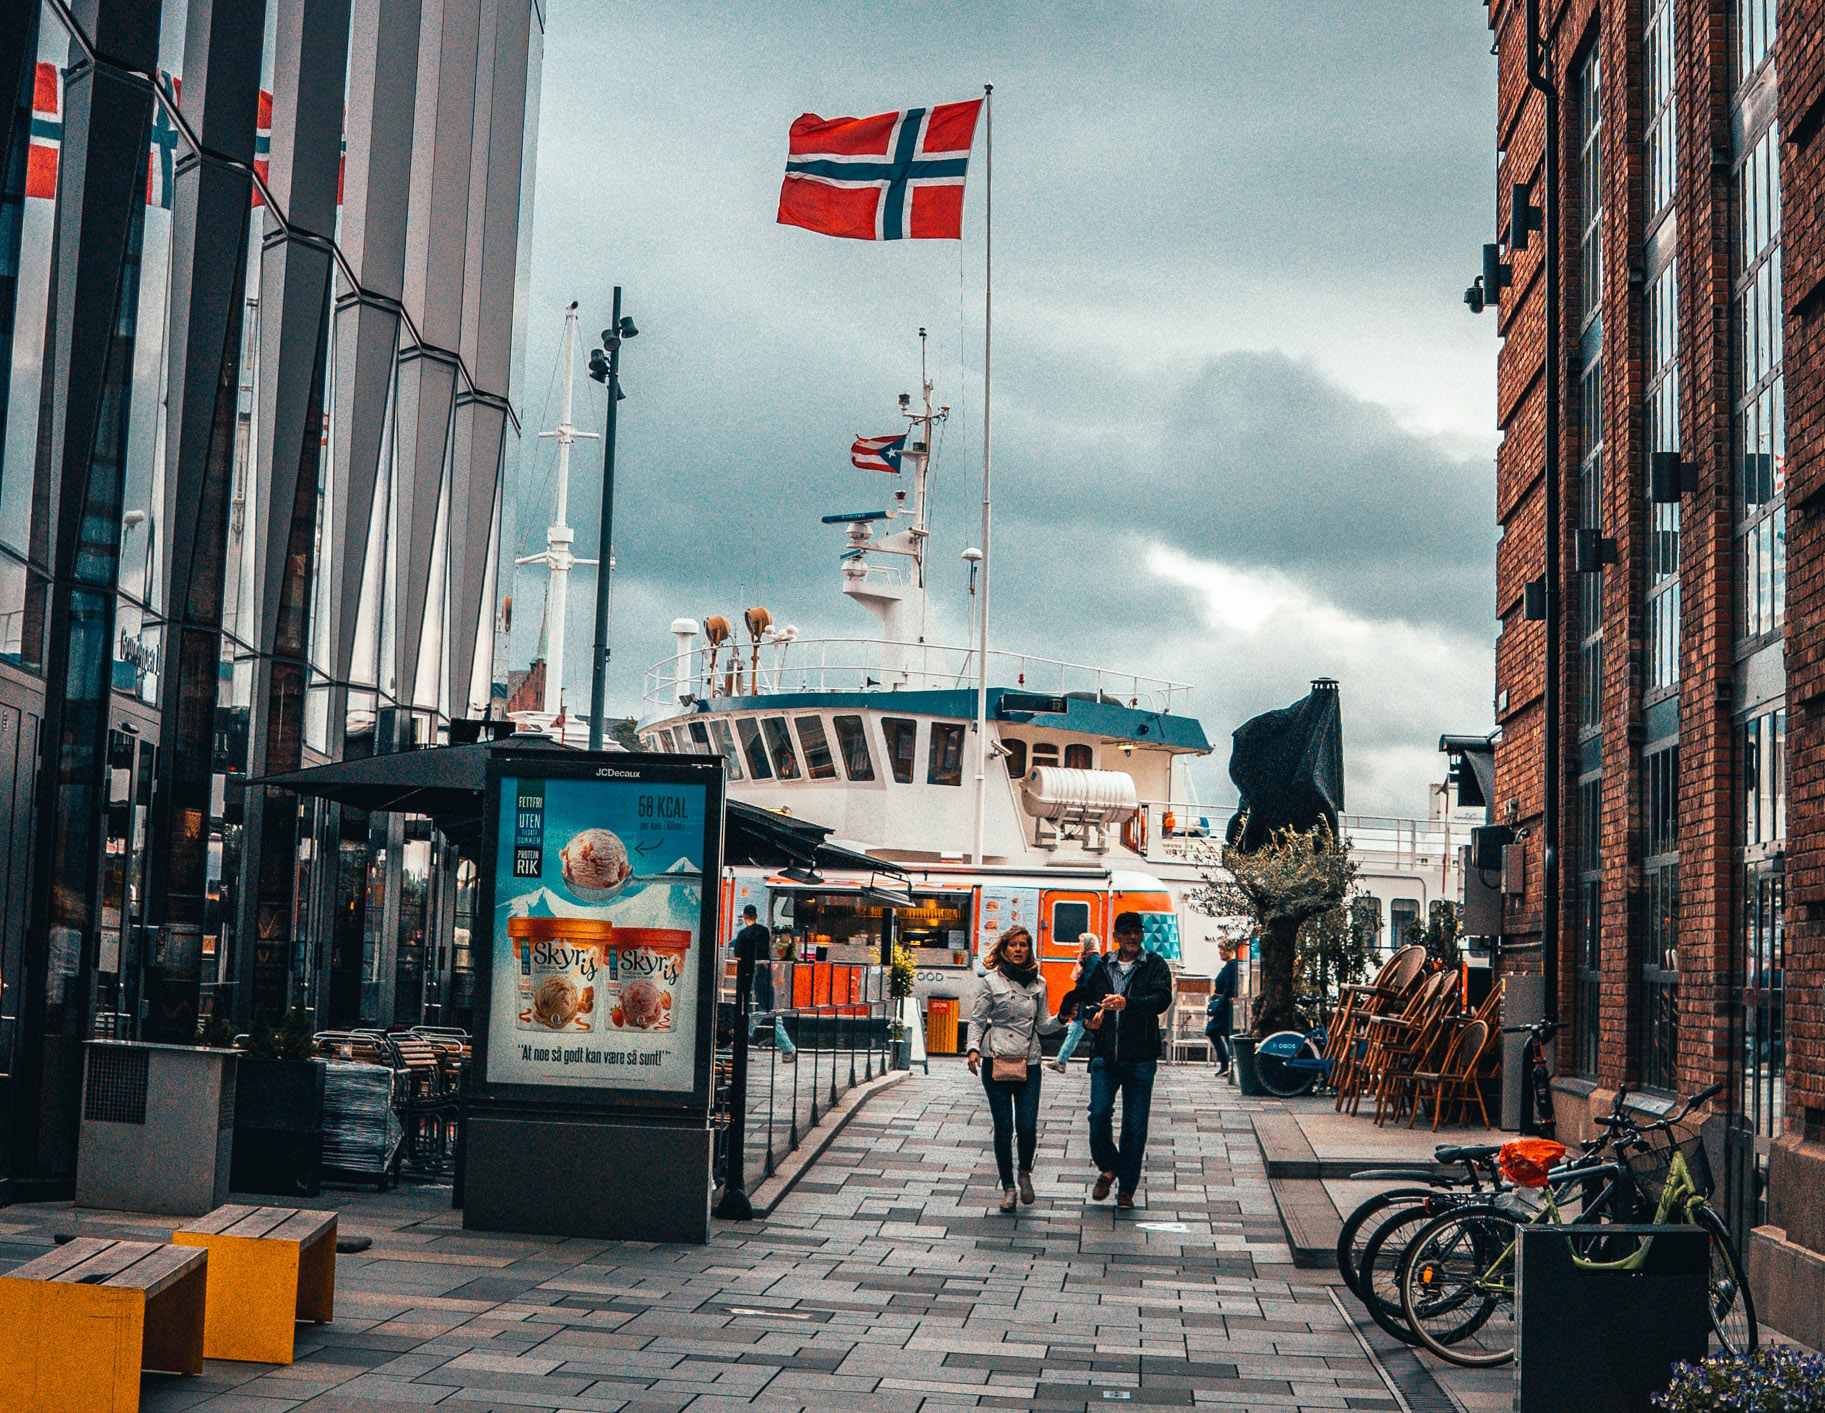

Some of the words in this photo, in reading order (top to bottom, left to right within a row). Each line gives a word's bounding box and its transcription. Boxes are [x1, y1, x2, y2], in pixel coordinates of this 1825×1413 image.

[595, 768, 641, 778] JCDecaux
[638, 796, 654, 818] 58
[657, 796, 689, 819] KCAL
[519, 813, 541, 829] UTEN
[517, 849, 540, 860] PROTEIN
[517, 859, 538, 875] RIK
[534, 1048, 550, 1061] noe
[551, 1045, 562, 1062] så
[564, 1046, 584, 1065] godt
[585, 1047, 602, 1064] kan
[603, 1051, 625, 1065] være
[626, 1049, 637, 1065] så
